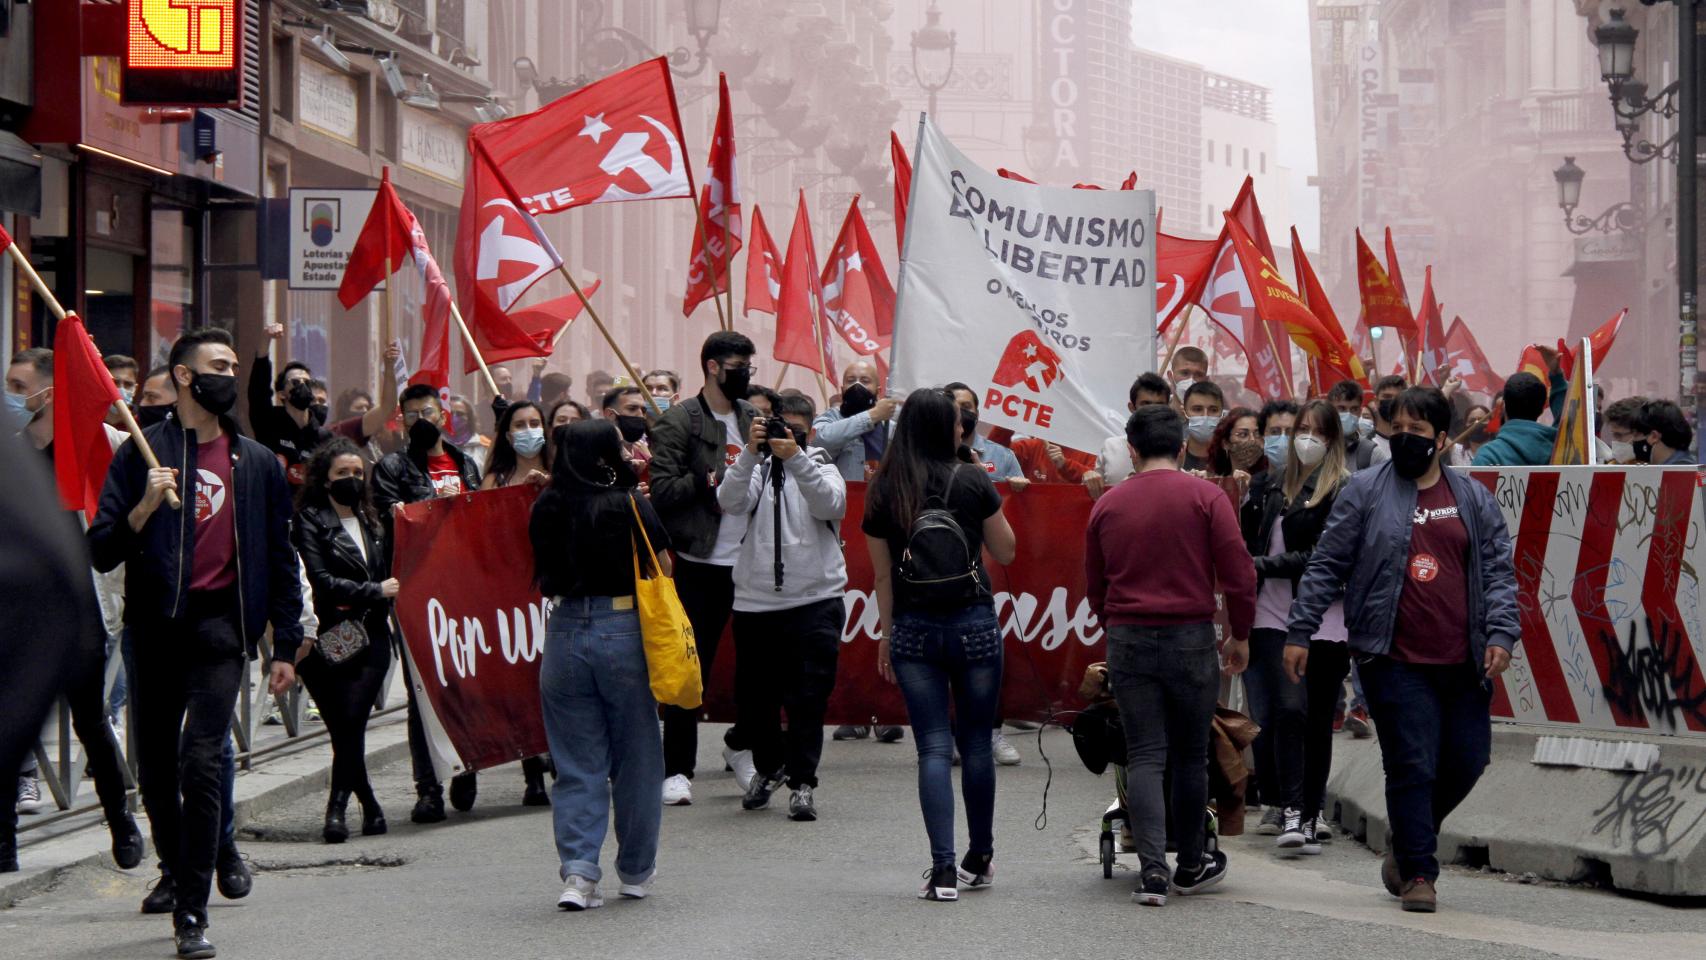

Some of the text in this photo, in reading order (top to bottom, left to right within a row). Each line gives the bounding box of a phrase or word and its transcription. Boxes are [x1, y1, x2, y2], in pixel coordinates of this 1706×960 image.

[950, 169, 1145, 249] COMUNISMO
[302, 272, 337, 281] Estado
[984, 229, 1147, 289] LIBERTAD
[983, 387, 1055, 429] PCTE
